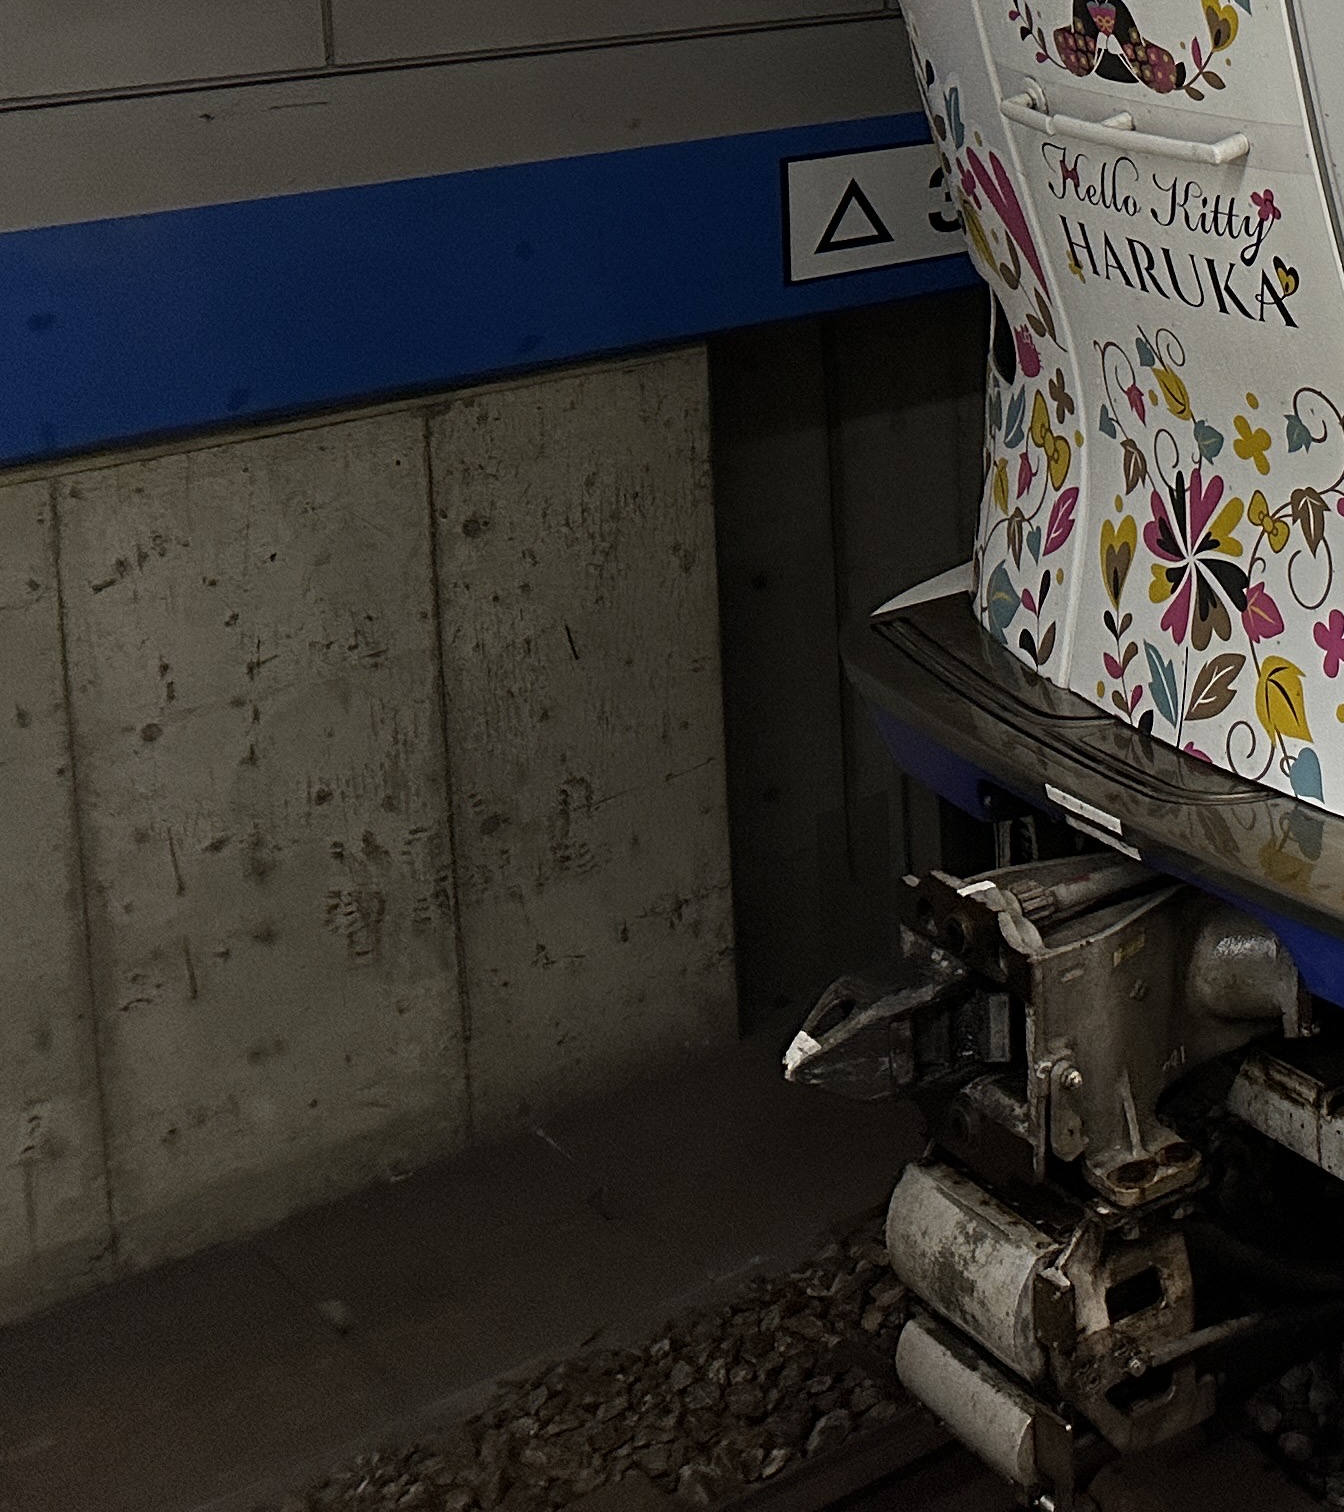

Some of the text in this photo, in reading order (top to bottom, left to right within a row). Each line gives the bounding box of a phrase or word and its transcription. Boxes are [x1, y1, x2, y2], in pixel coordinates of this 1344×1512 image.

[1041, 142, 1276, 267] Hello Kitty
[1059, 214, 1299, 328] HARUKA
